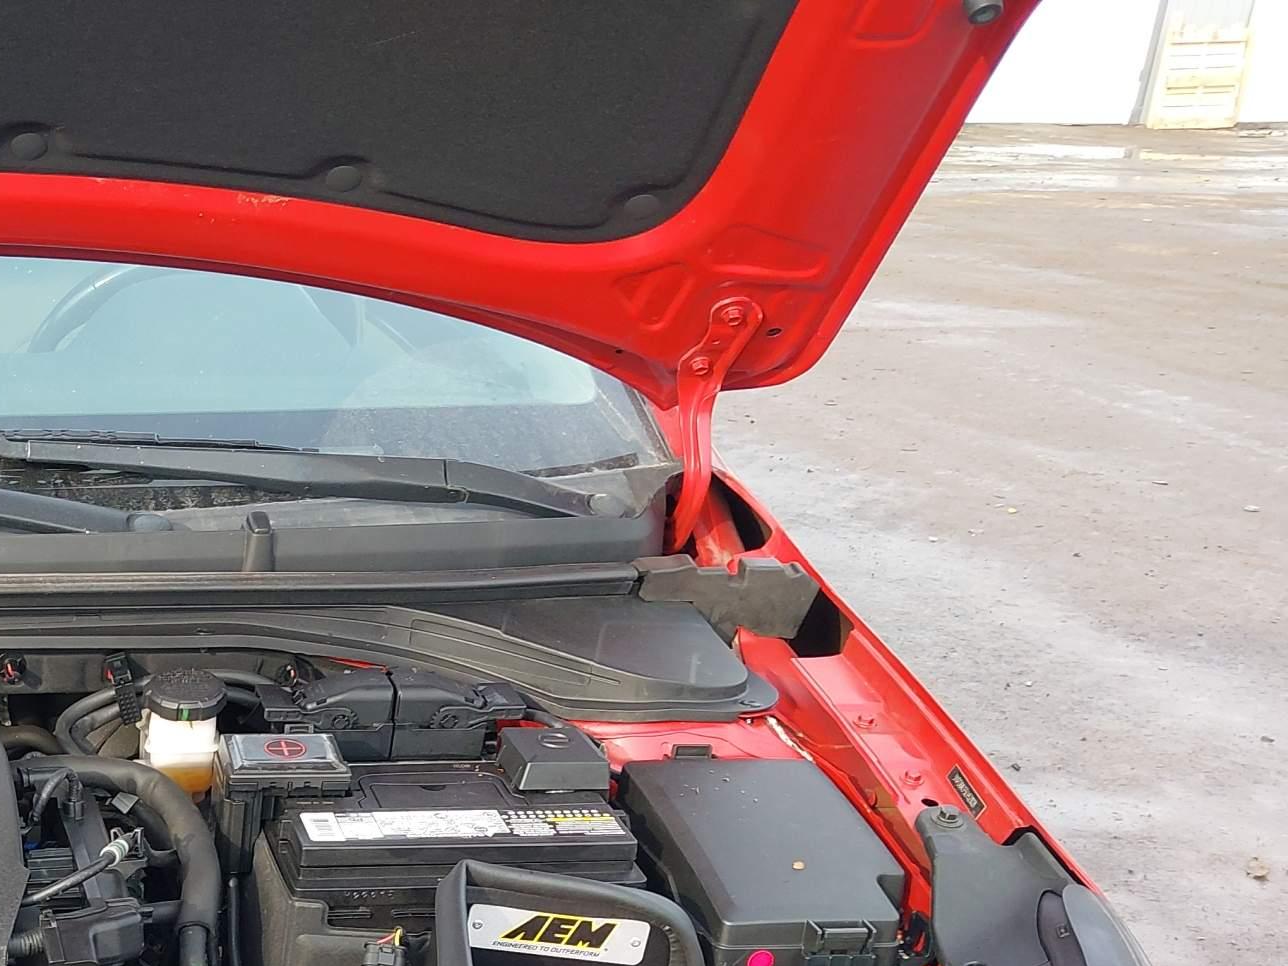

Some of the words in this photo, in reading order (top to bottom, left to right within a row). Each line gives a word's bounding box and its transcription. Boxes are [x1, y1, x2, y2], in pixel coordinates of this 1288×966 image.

[500, 912, 618, 950] AEM
[491, 940, 538, 951] ENGINEERED
[539, 944, 550, 953] TO
[550, 946, 601, 958] OUTPERFORM
